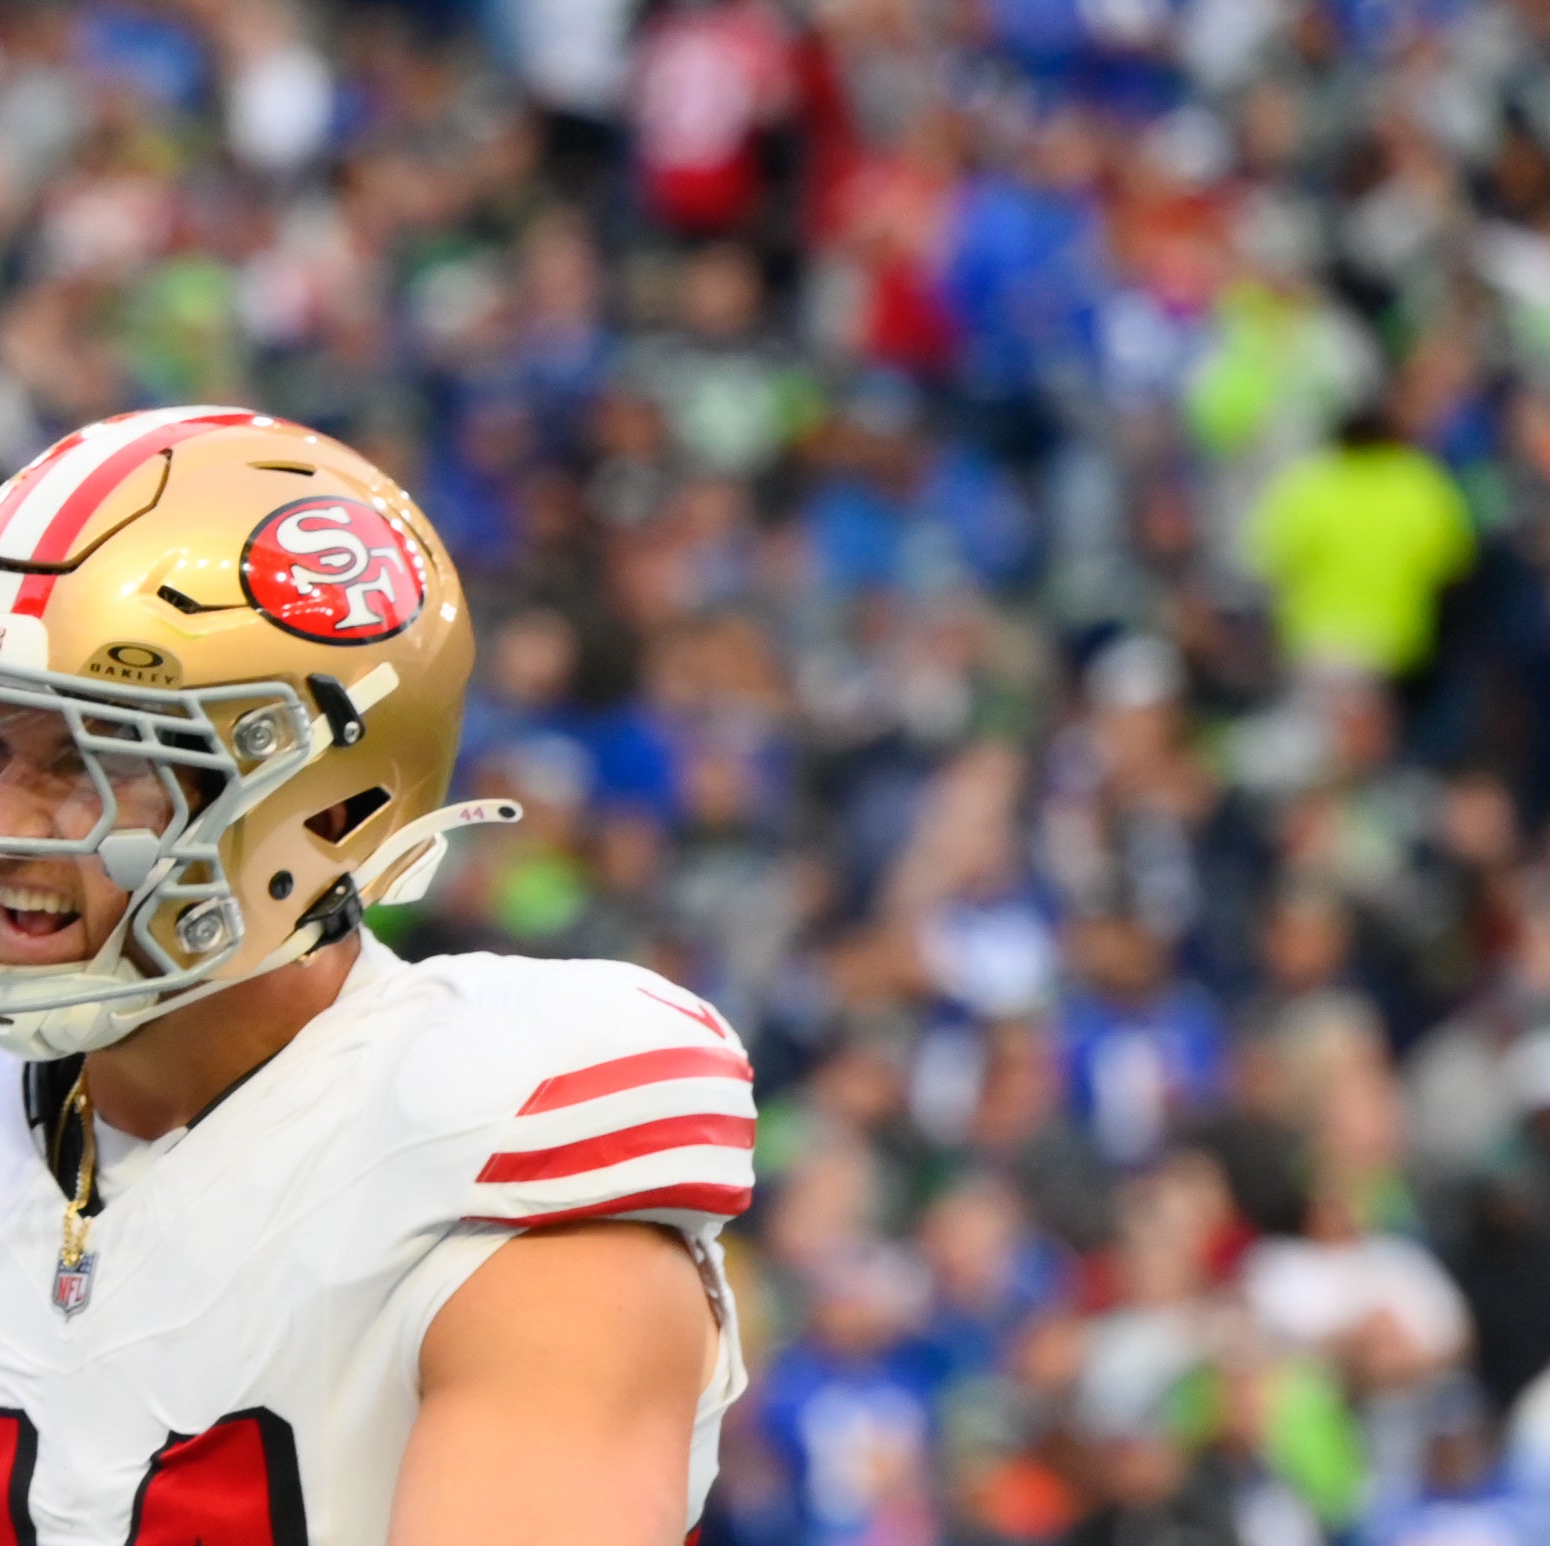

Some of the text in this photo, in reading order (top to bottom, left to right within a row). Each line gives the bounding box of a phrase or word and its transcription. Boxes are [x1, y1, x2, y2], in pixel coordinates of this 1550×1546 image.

[276, 505, 406, 630] SF
[90, 662, 176, 686] OAKLEY
[460, 806, 484, 821] 44
